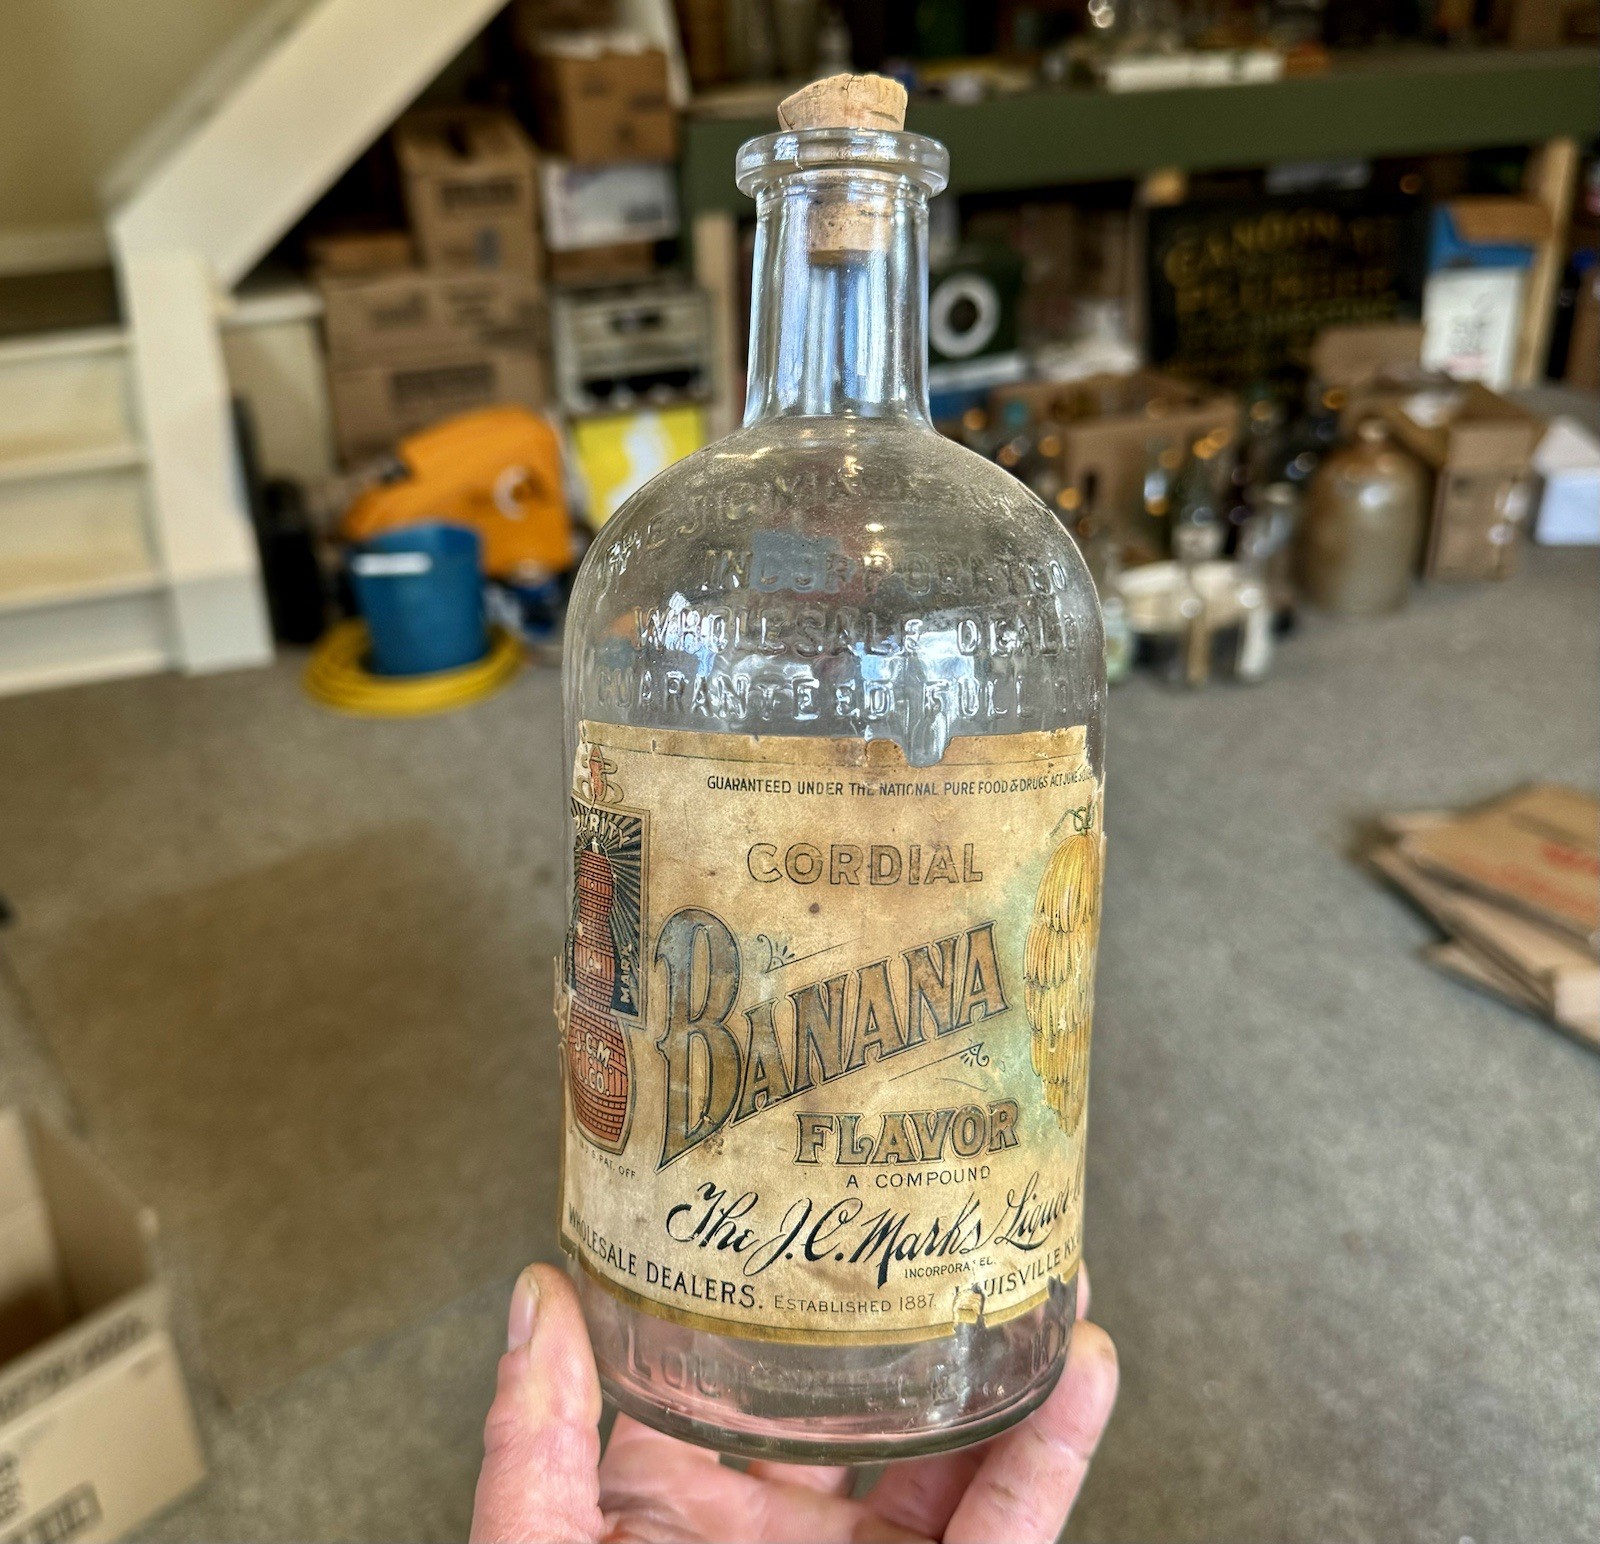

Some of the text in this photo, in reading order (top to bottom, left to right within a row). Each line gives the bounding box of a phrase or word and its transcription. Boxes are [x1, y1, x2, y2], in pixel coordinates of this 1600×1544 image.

[707, 775, 791, 794] GUARANTEED
[797, 781, 843, 796] UNDER
[849, 782, 875, 797] THE
[879, 782, 938, 797] NATIONAL
[943, 781, 975, 796] PURE
[978, 779, 1008, 795] FOOD
[1009, 778, 1020, 793] &
[1020, 775, 1049, 793] DRUGS
[1050, 773, 1063, 788] ACT
[747, 842, 983, 886] CORDIAL
[619, 943, 633, 1004] MARK
[654, 904, 1014, 1176] BANANA
[793, 1097, 1021, 1168] FLAVOR
[845, 1165, 991, 1189] A COMPOUND
[568, 1202, 638, 1277] WHOLESALE
[646, 1260, 764, 1310] DEALERS.
[773, 1293, 892, 1313] ESTABLISHED
[665, 1181, 761, 1254] The
[842, 1192, 992, 1290] Marks
